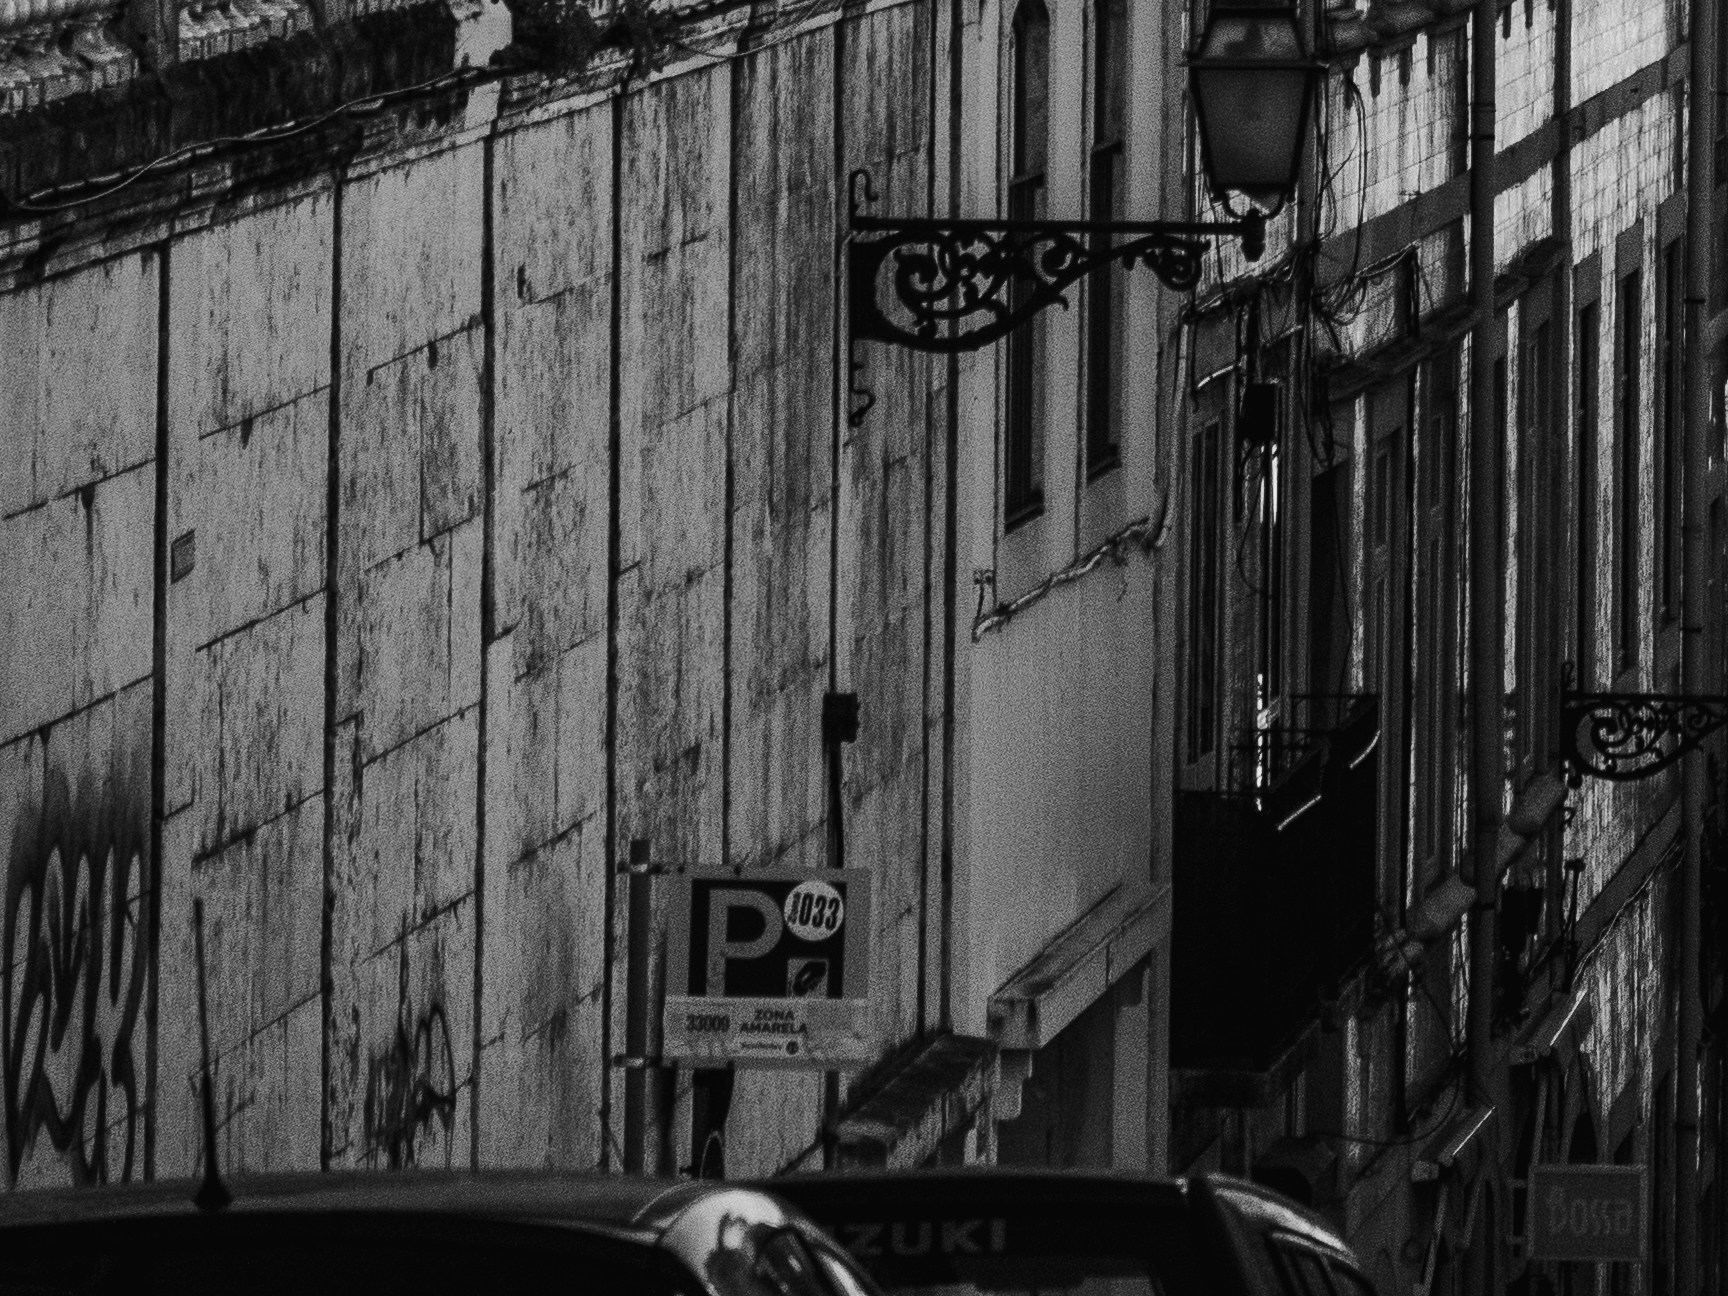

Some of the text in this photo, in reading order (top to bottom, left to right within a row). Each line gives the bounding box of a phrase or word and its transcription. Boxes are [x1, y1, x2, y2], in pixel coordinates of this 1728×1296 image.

[706, 889, 783, 996] P
[754, 1009, 794, 1021] ZONA
[740, 1022, 807, 1034] AMARELA
[826, 1218, 1007, 1256] ZUKI
